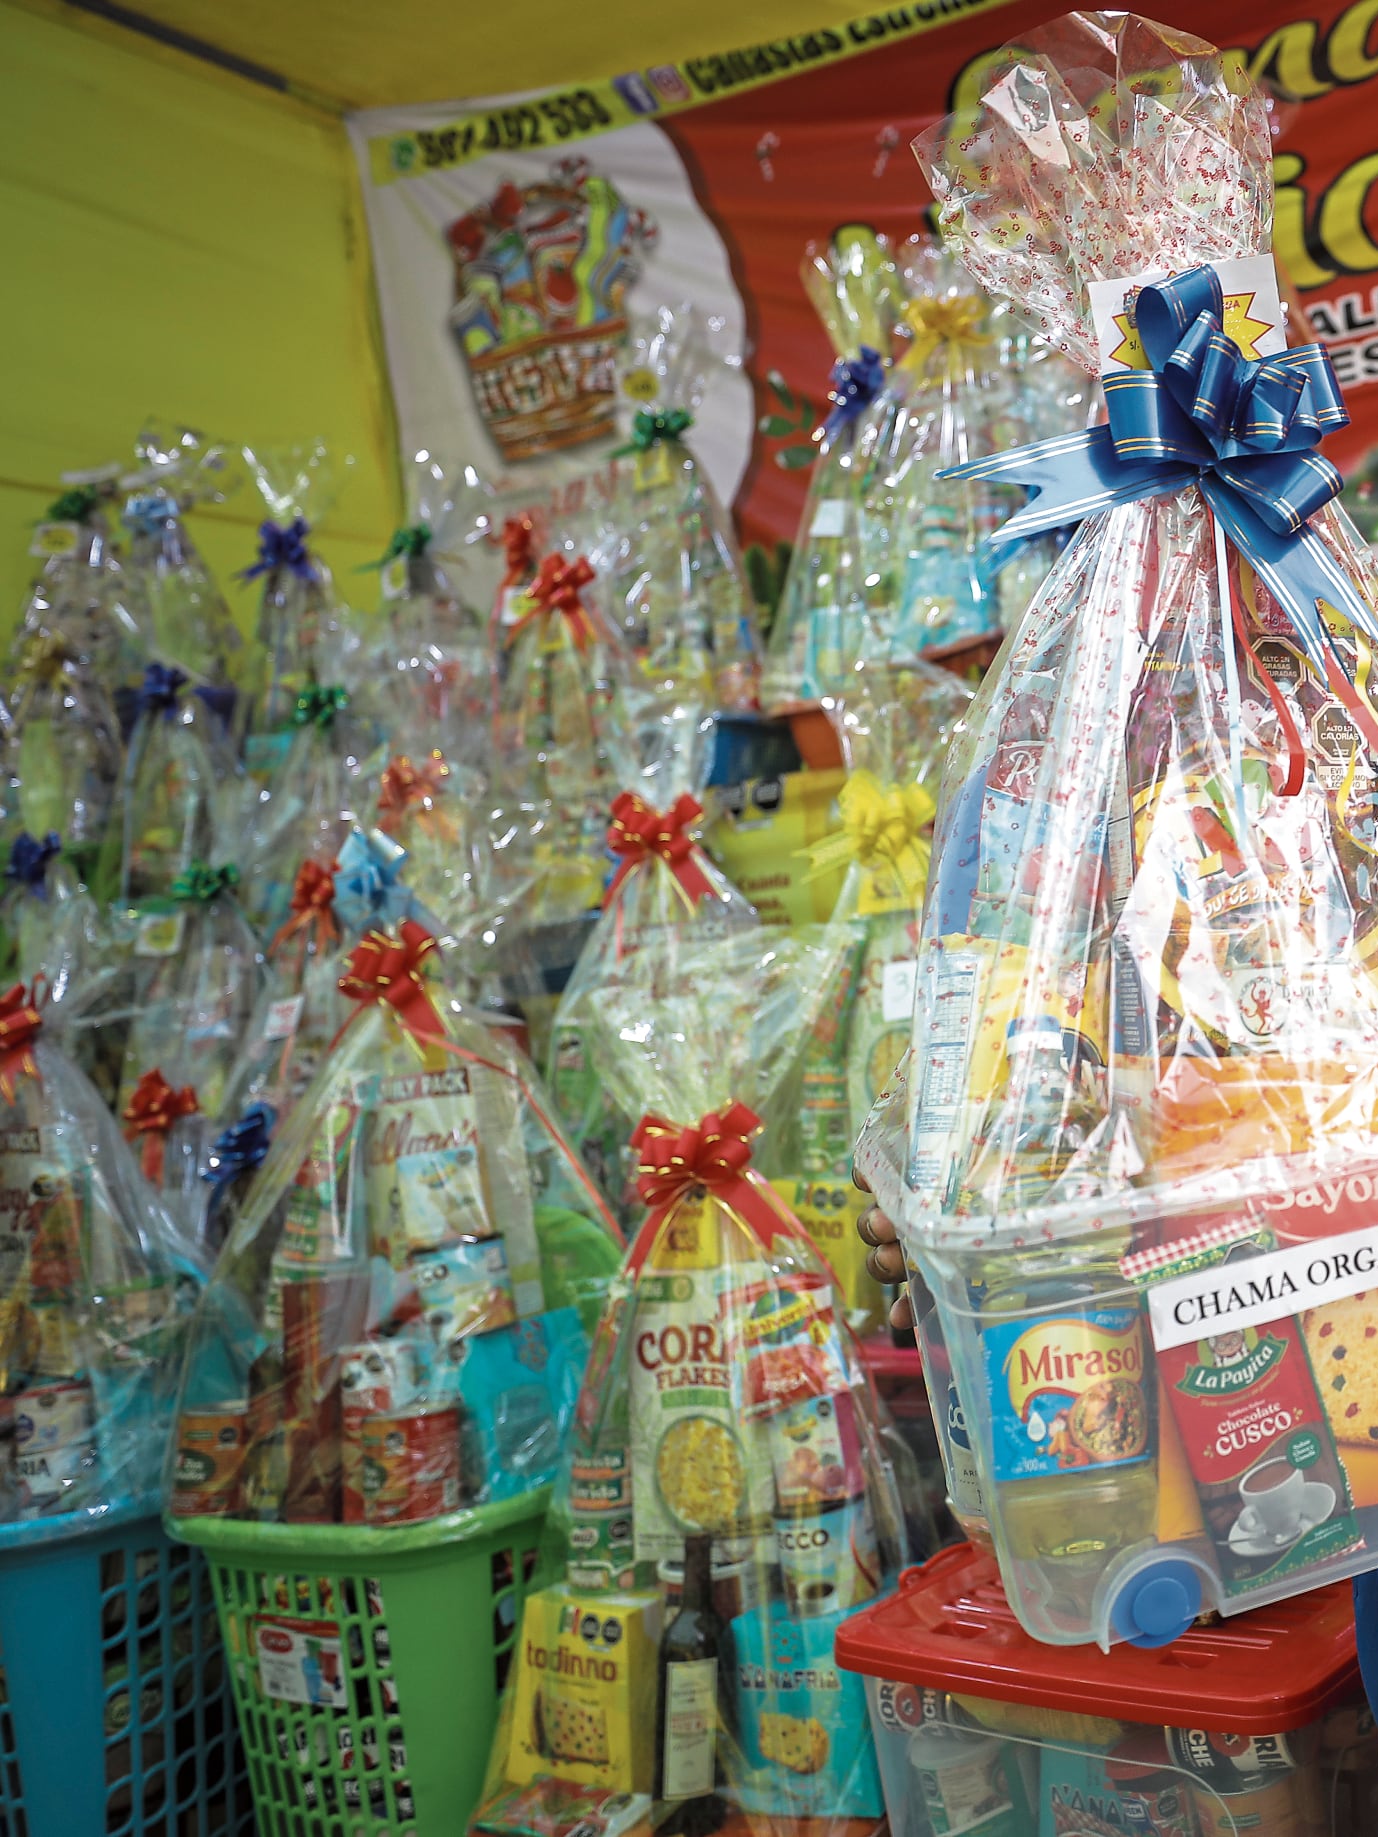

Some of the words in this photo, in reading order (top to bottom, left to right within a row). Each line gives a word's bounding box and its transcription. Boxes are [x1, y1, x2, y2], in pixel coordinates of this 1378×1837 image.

[1257, 670, 1298, 678] TURADAS
[1172, 1270, 1300, 1326] CHAMA
[1195, 1369, 1217, 1388] La
[1220, 1345, 1273, 1388] Payita
[1215, 1411, 1292, 1456] CUSCO
[1217, 1402, 1282, 1435] Chocolate
